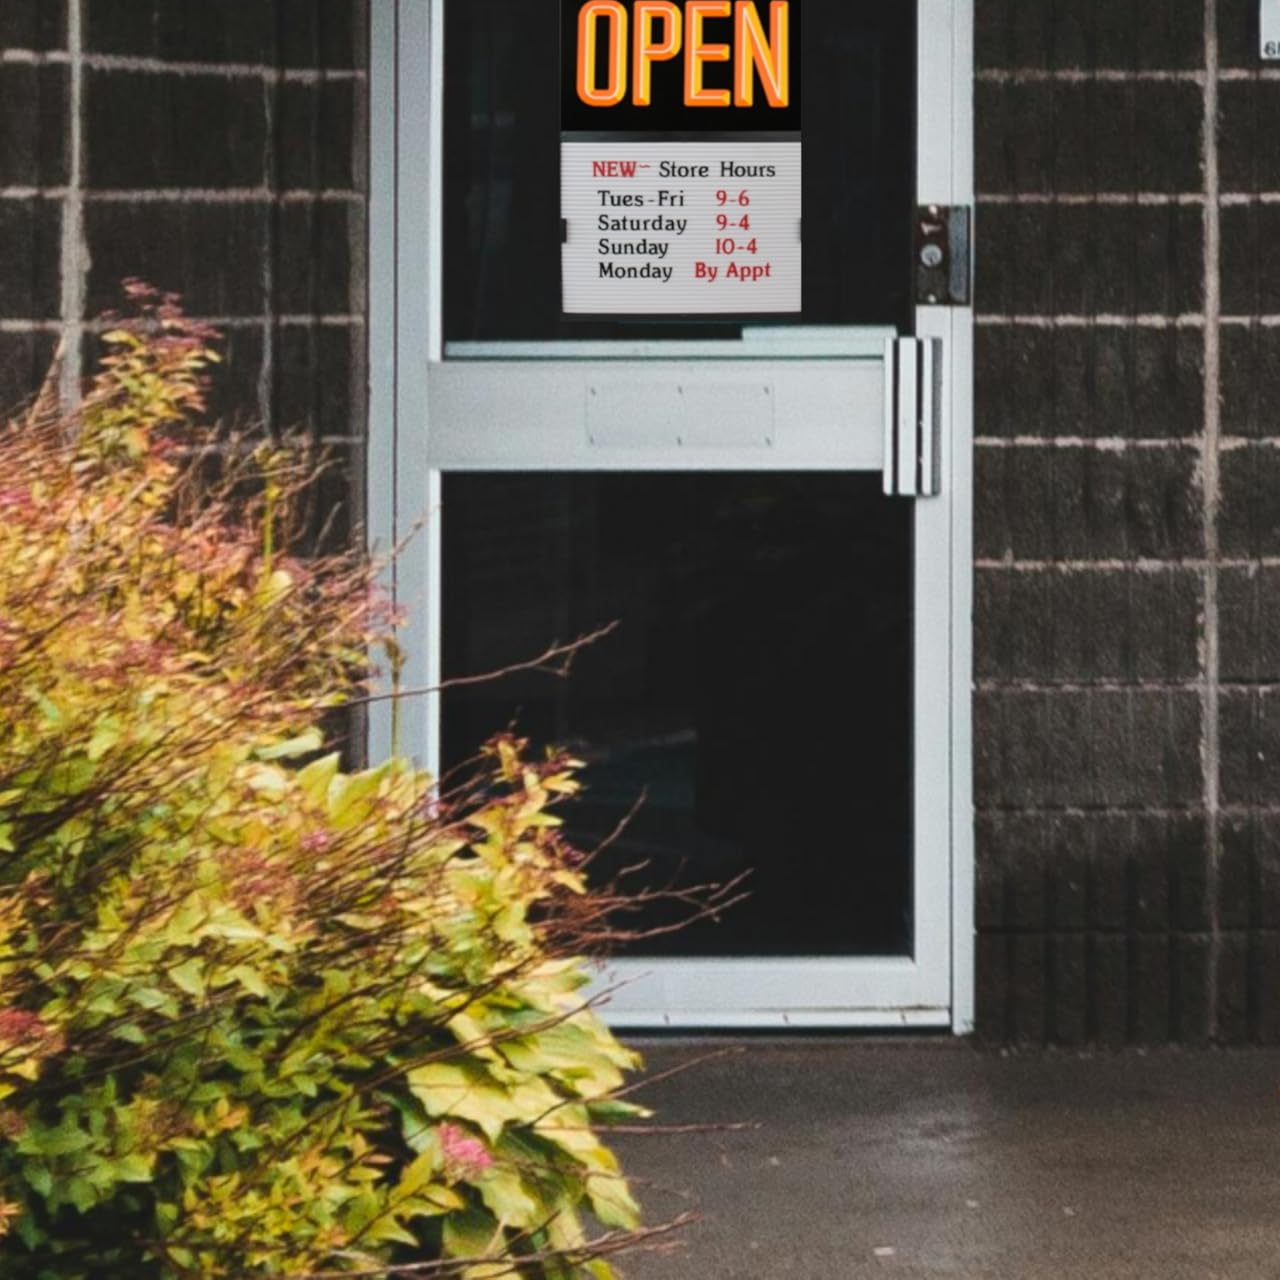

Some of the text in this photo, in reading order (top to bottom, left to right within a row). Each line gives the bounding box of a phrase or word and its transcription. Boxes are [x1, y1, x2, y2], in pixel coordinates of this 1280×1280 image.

[576, 0, 789, 107] OPEN
[659, 161, 709, 177] Store
[720, 162, 775, 177] Hours
[716, 190, 749, 207] 9-6
[598, 214, 750, 234] Saturday 9-4
[598, 238, 758, 258] Sunday 10-4
[599, 262, 771, 282] Monday By Appt
